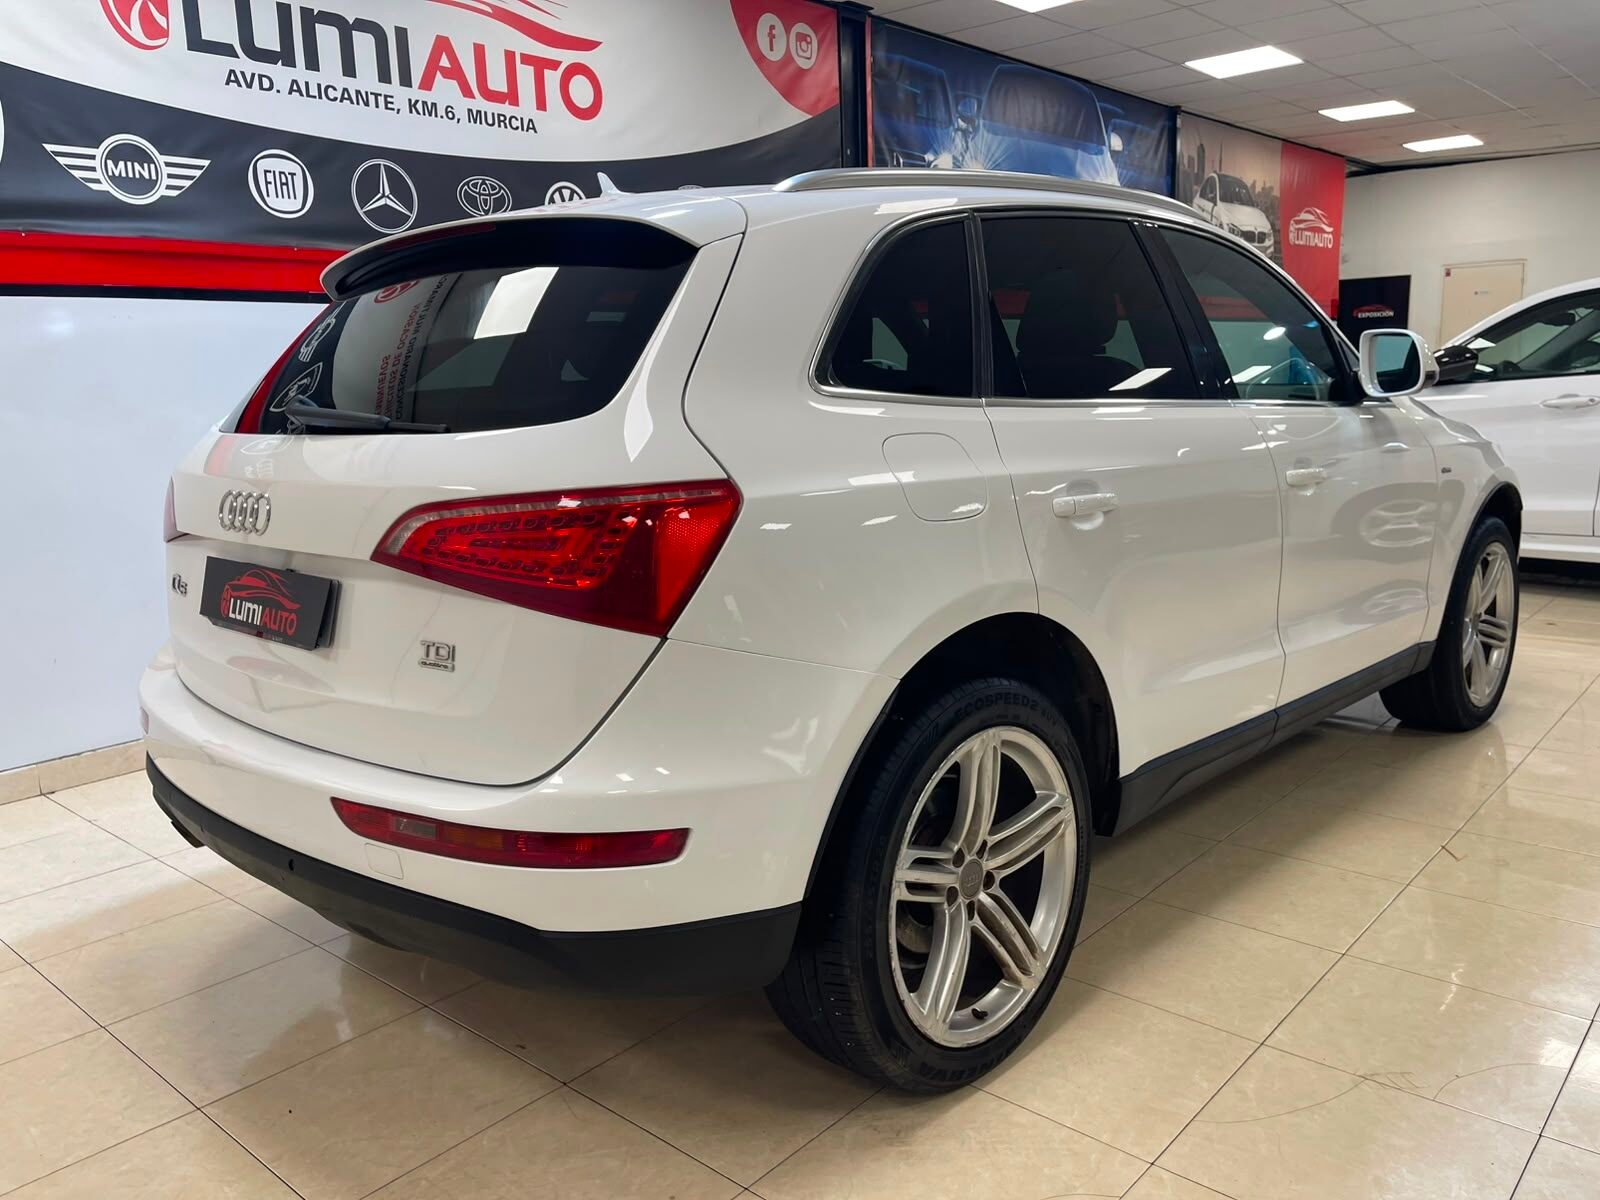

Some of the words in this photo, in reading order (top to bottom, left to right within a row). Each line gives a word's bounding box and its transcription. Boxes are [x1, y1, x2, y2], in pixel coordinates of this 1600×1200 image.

[225, 68, 281, 94] AVD.
[287, 78, 401, 115] ALICANTE,
[408, 98, 461, 124] KM.6,
[467, 107, 538, 134] MURCIA
[106, 158, 157, 180] MINI
[263, 168, 297, 200] FIAT
[420, 640, 456, 662] TDI
